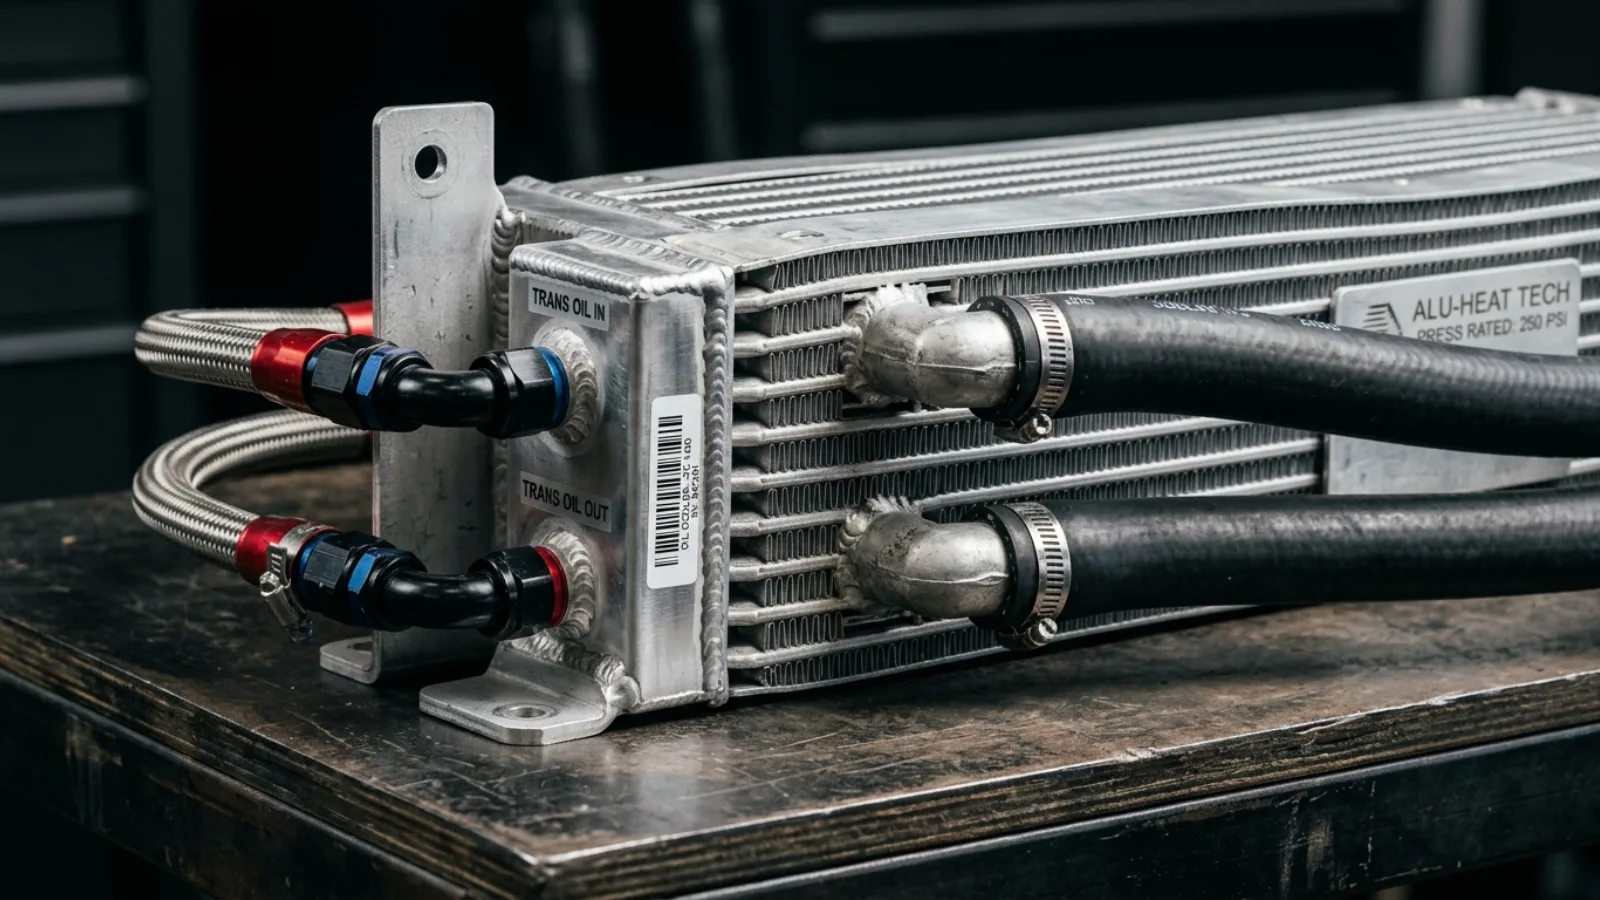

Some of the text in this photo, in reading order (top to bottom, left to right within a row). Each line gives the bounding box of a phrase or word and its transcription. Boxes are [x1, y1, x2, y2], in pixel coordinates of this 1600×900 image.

[532, 287, 605, 321] TRANS OIL IN
[1412, 281, 1571, 322] ALU-HEAT TECH
[1417, 324, 1463, 343] PRESS
[1519, 314, 1542, 333] 250
[1546, 311, 1568, 328] PSI
[522, 479, 609, 522] TRANS OIL OUT
